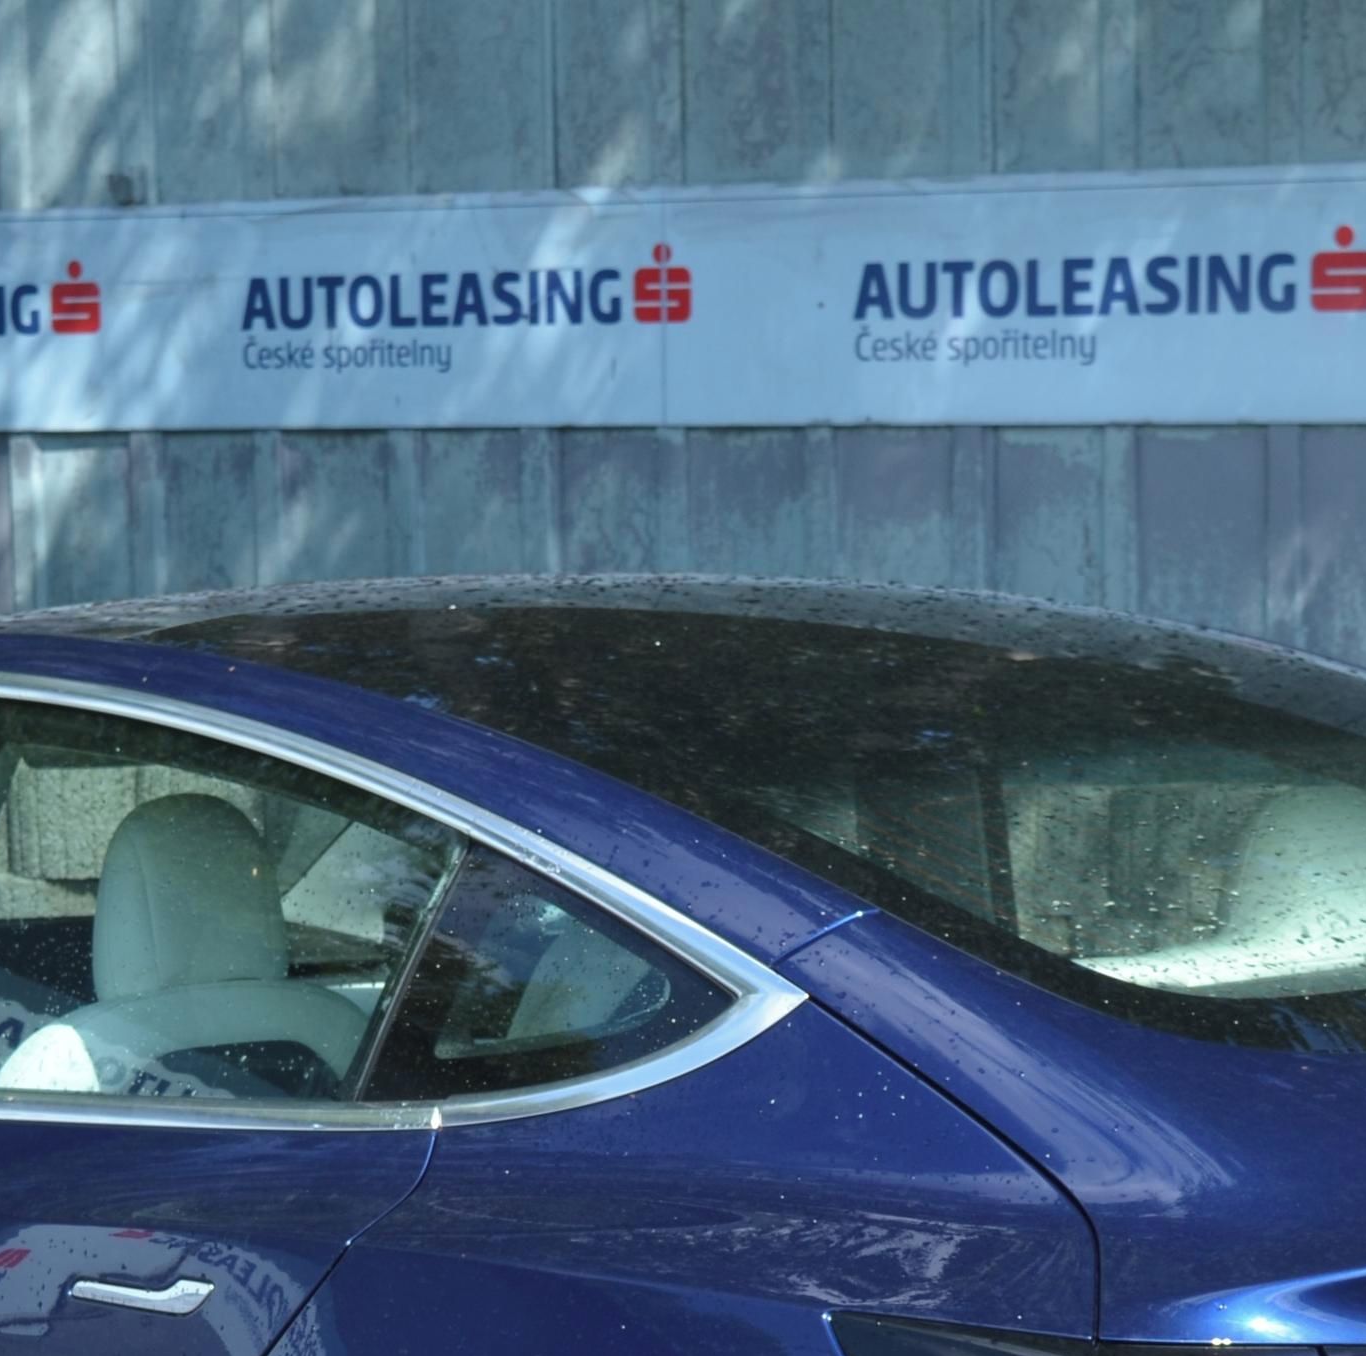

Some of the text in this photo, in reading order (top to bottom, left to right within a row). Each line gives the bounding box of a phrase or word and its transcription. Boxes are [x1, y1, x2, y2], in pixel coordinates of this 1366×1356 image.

[242, 268, 622, 331] AUTOLEASING
[853, 252, 1297, 320] AUTOLEASING
[243, 336, 452, 374] České spořitelny
[855, 326, 1097, 366] České spořitelny
